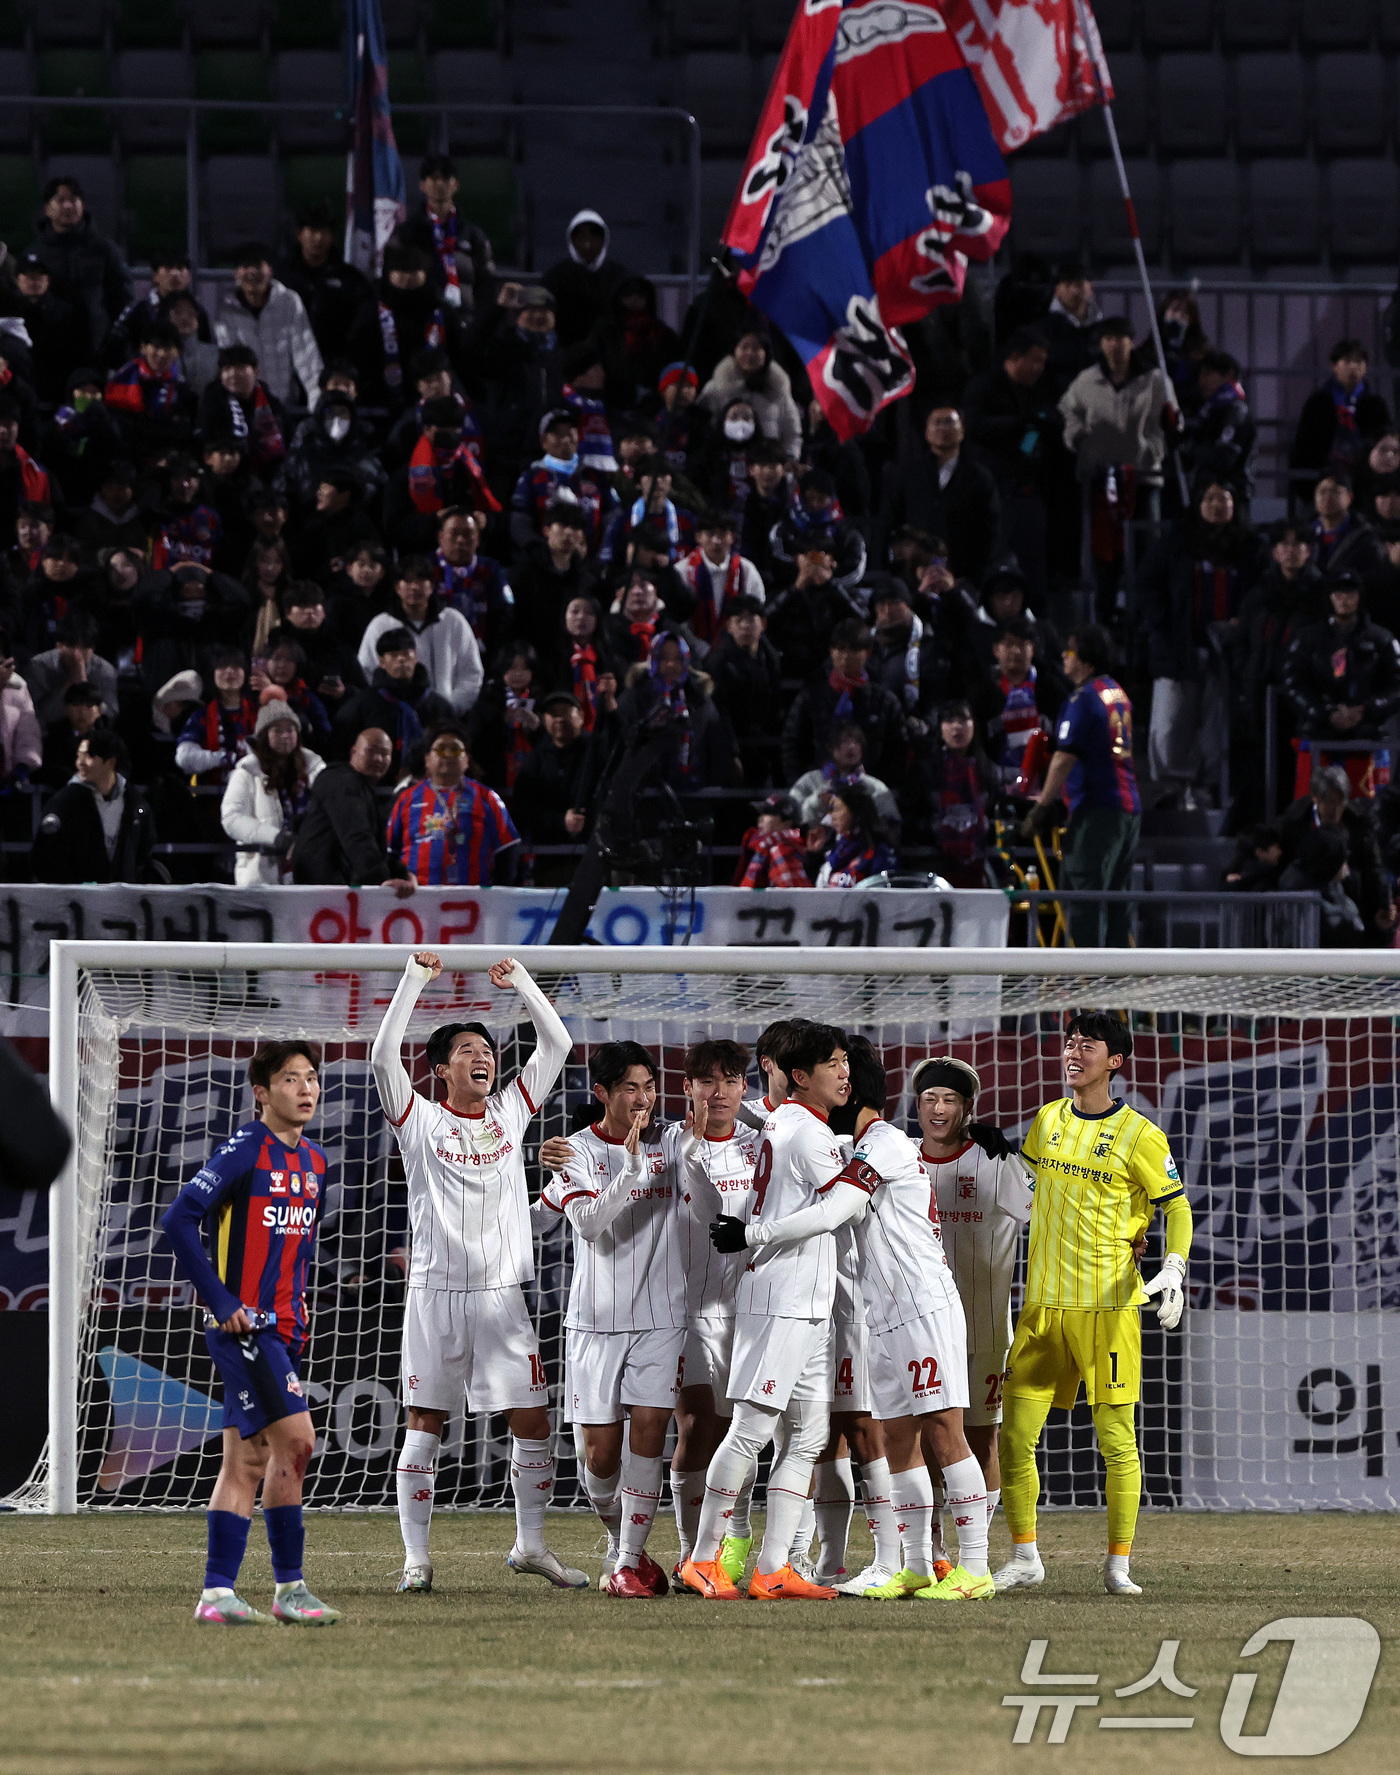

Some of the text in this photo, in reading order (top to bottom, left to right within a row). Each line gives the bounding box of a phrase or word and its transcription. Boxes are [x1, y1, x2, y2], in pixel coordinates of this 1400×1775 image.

[630, 1185, 673, 1201] 한방병원
[938, 1210, 983, 1223] 한방병원
[528, 1353, 547, 1386] 18
[908, 1356, 942, 1392] 22
[1109, 1352, 1118, 1383] 1
[915, 1388, 941, 1399] KELME
